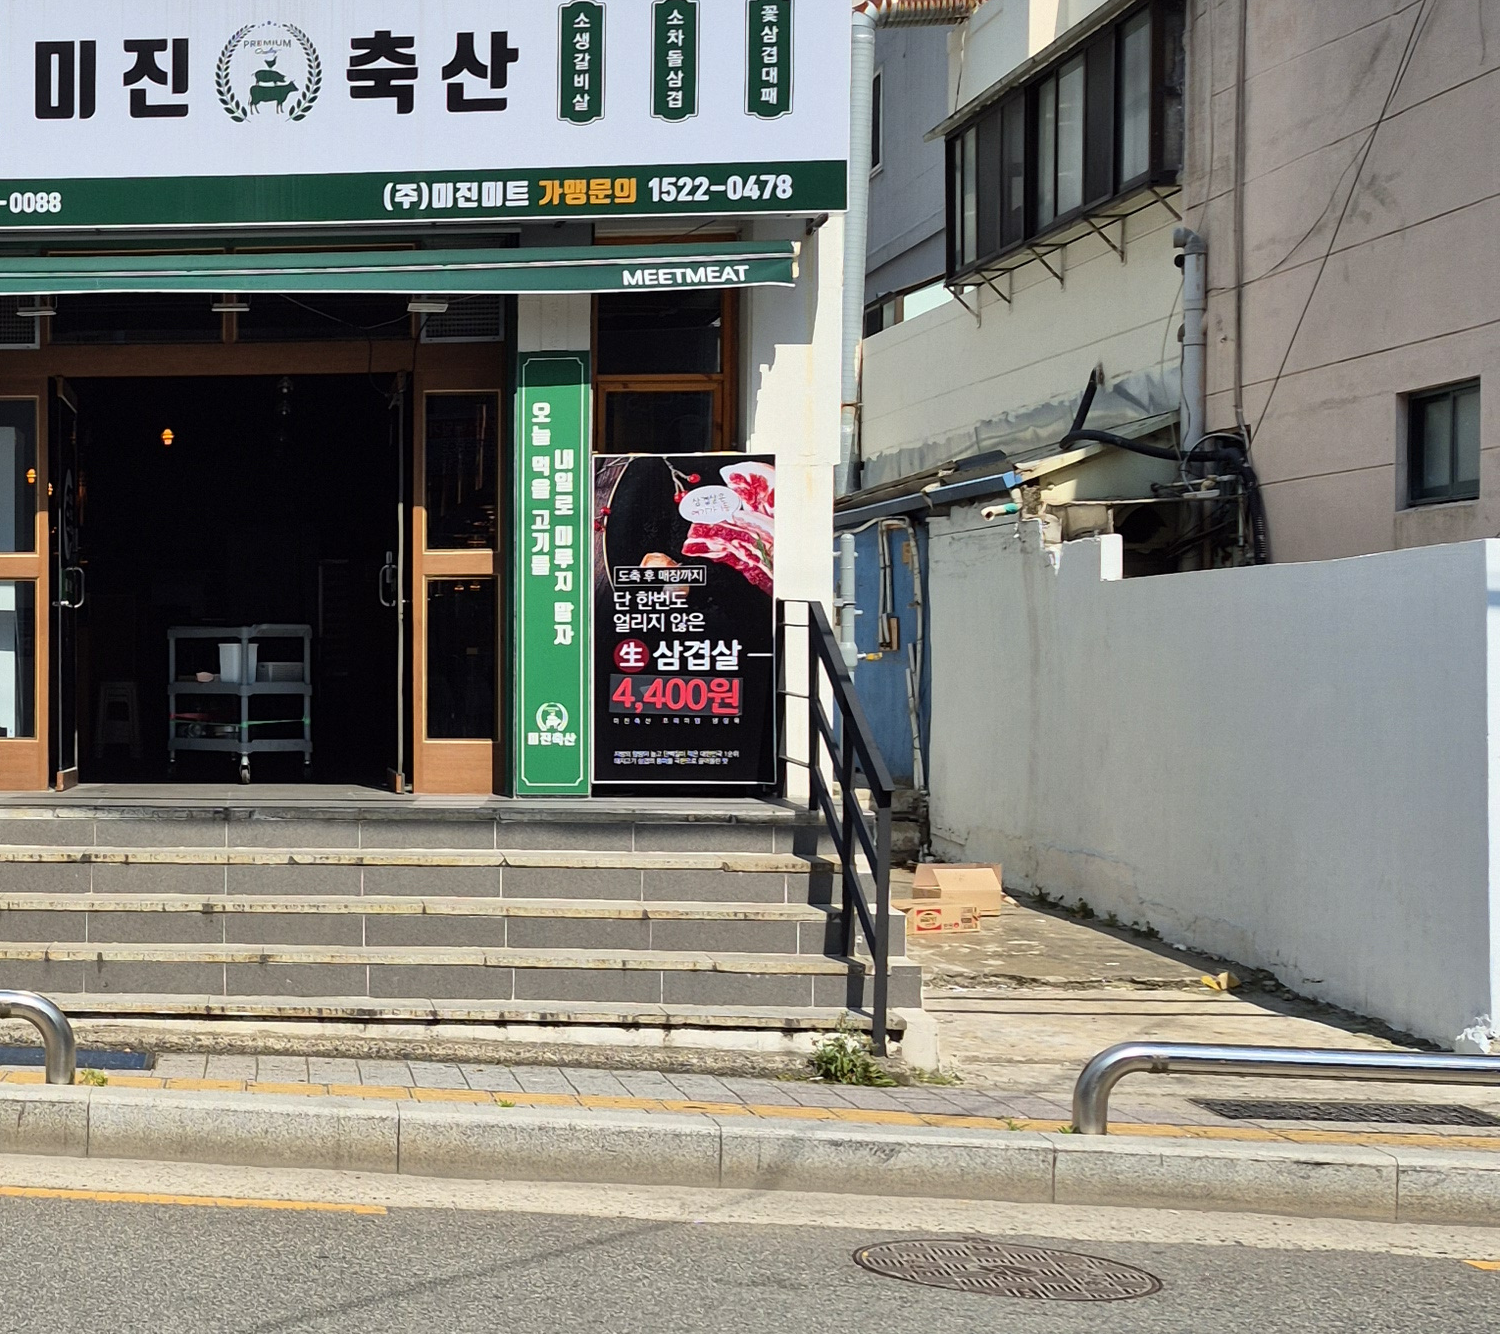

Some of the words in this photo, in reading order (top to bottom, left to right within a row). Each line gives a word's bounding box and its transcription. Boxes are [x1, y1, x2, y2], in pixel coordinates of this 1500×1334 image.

[243, 39, 292, 49] PREMIUM
[573, 11, 591, 112] 소생갈비살
[666, 8, 684, 108] 소차돌삼겹
[760, 4, 779, 105] 꽃삼겹대패
[35, 37, 189, 120] 미진
[346, 30, 519, 115] 축산
[383, 180, 529, 211] (주)미진미트
[538, 177, 638, 206] 가맹문의
[648, 175, 793, 202] 1522-0478
[622, 265, 749, 286] MEETMEAT
[531, 402, 551, 446] 오늘
[531, 456, 551, 499] 먹을
[554, 449, 574, 515] 내일로
[554, 525, 574, 592] 미루지
[618, 569, 641, 582] 도축
[643, 569, 655, 582] 후
[658, 568, 703, 582] 매장까지
[613, 591, 631, 610] 단
[636, 591, 689, 610] 한번도
[553, 601, 575, 646] 말자
[613, 613, 665, 633] 얼리지
[670, 612, 706, 632] 않은
[619, 641, 645, 667] 生
[652, 639, 742, 671] 삼겹살
[612, 677, 739, 714] 4,400원
[527, 732, 577, 746] 미진축산
